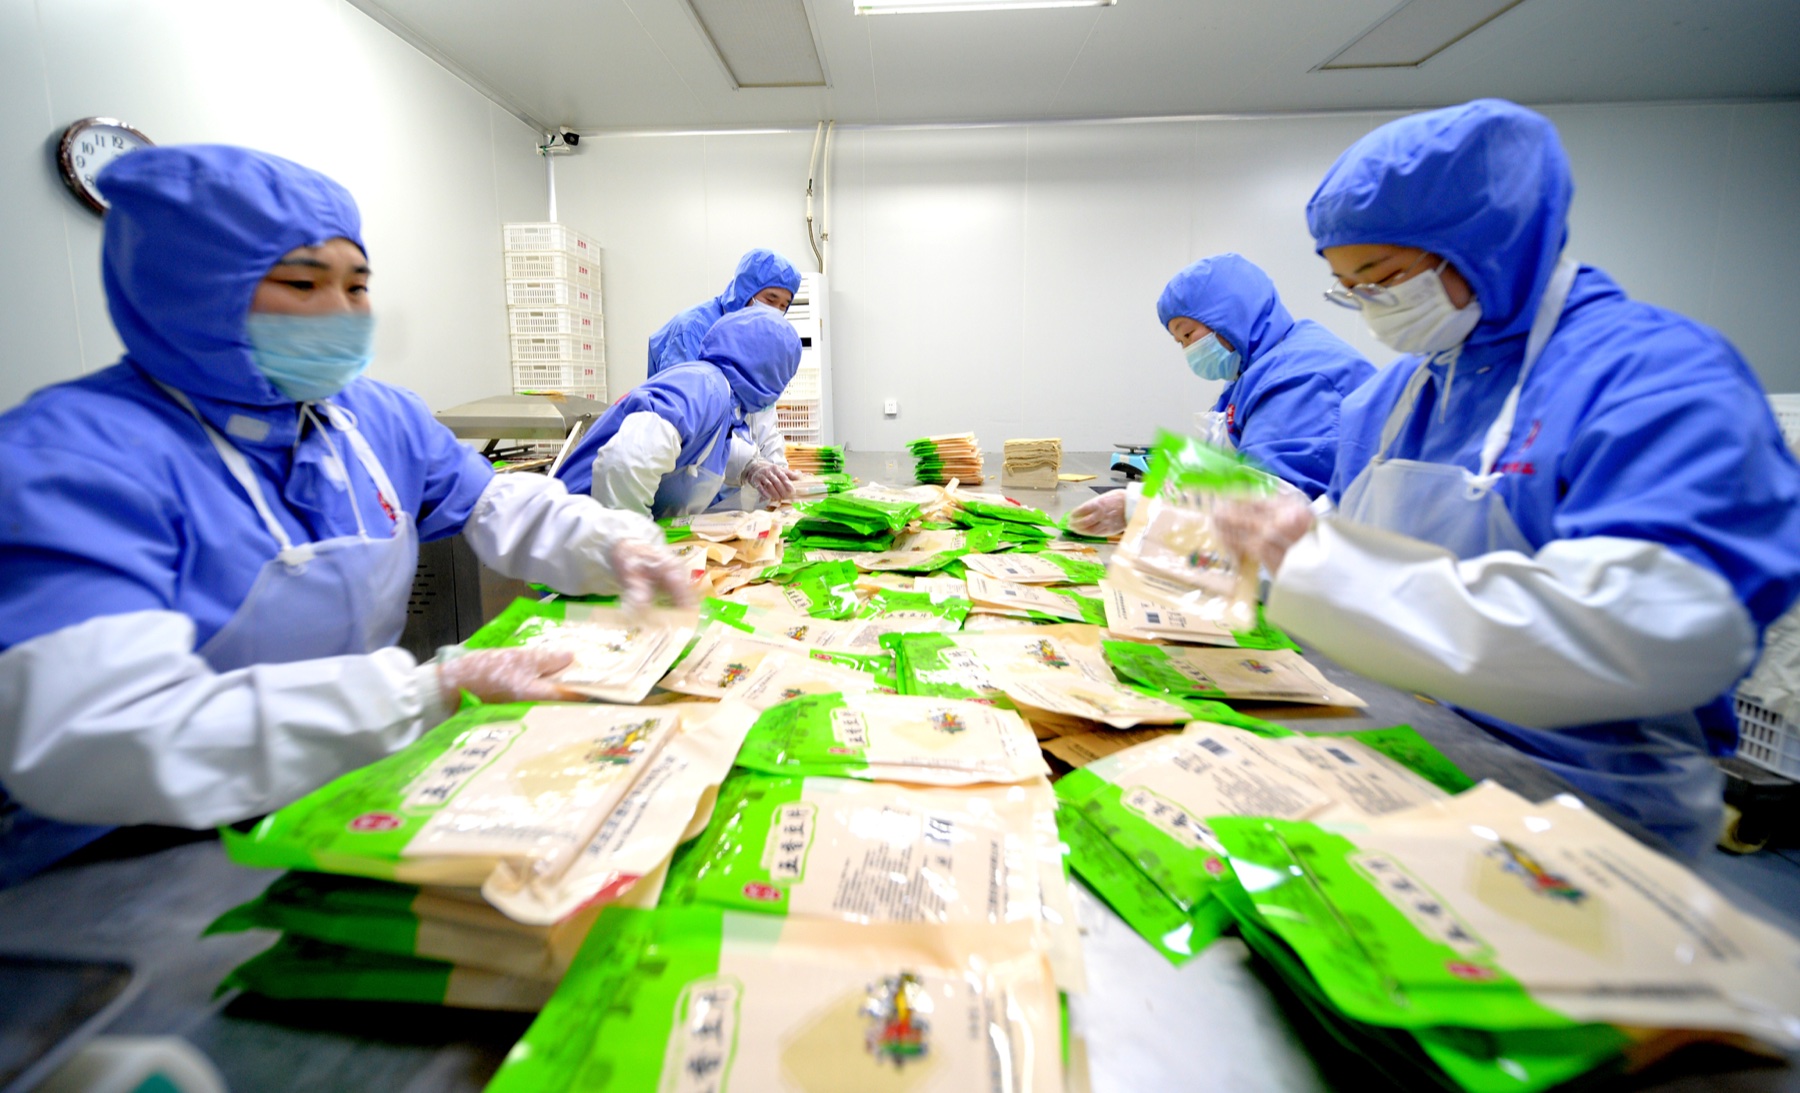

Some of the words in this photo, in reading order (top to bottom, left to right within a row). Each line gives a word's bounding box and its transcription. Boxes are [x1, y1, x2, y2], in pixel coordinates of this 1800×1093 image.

[82, 141, 94, 155] 10
[95, 134, 105, 148] 11
[112, 135, 124, 150] 12
[76, 155, 86, 168] 9
